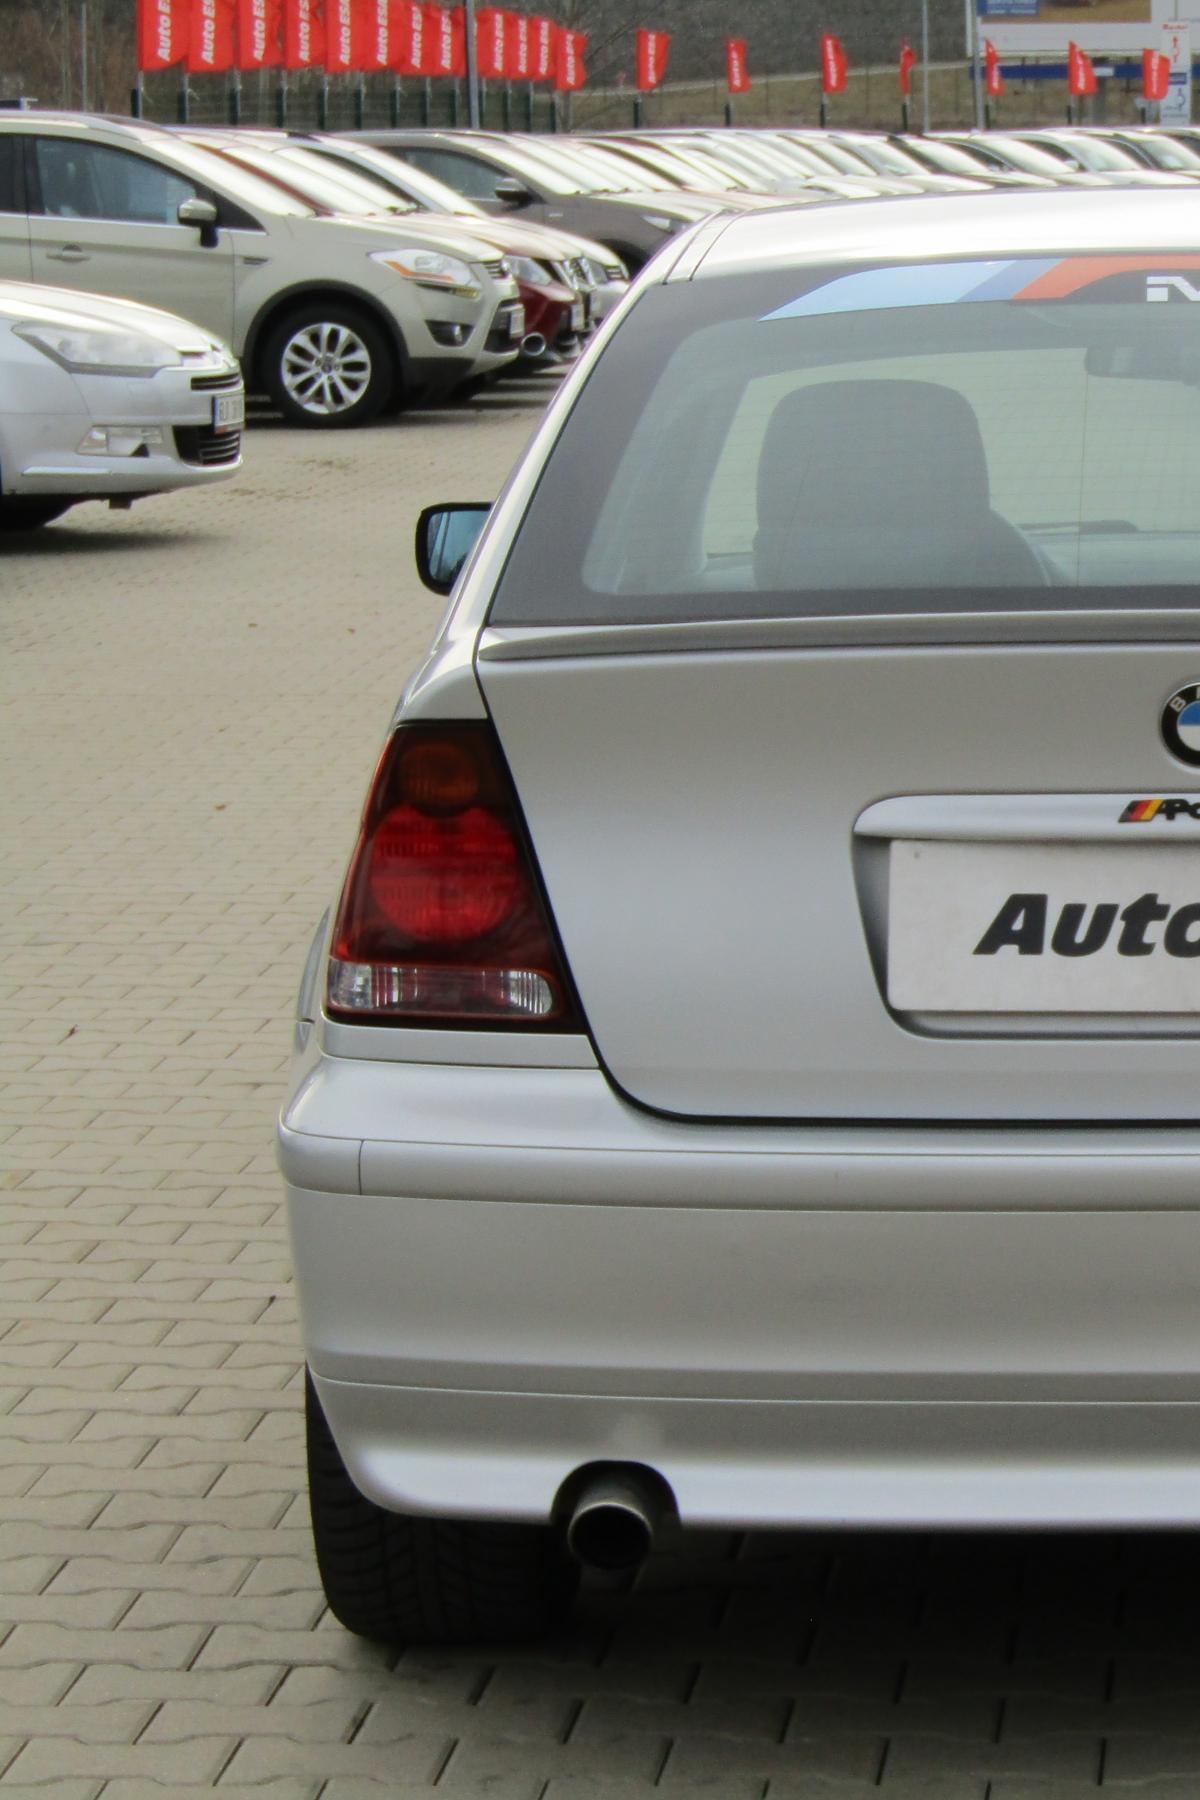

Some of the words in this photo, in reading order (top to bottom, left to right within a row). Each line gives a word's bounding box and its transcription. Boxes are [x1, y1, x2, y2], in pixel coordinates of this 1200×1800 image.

[157, 14, 171, 62] Auto
[201, 18, 214, 64] Auto
[253, 19, 266, 61] Auto
[298, 21, 310, 62] Auto
[339, 26, 350, 65] Auto
[376, 27, 388, 65] Auto
[410, 31, 422, 69] Auto
[440, 34, 452, 70] Auto
[493, 38, 504, 72] Auto
